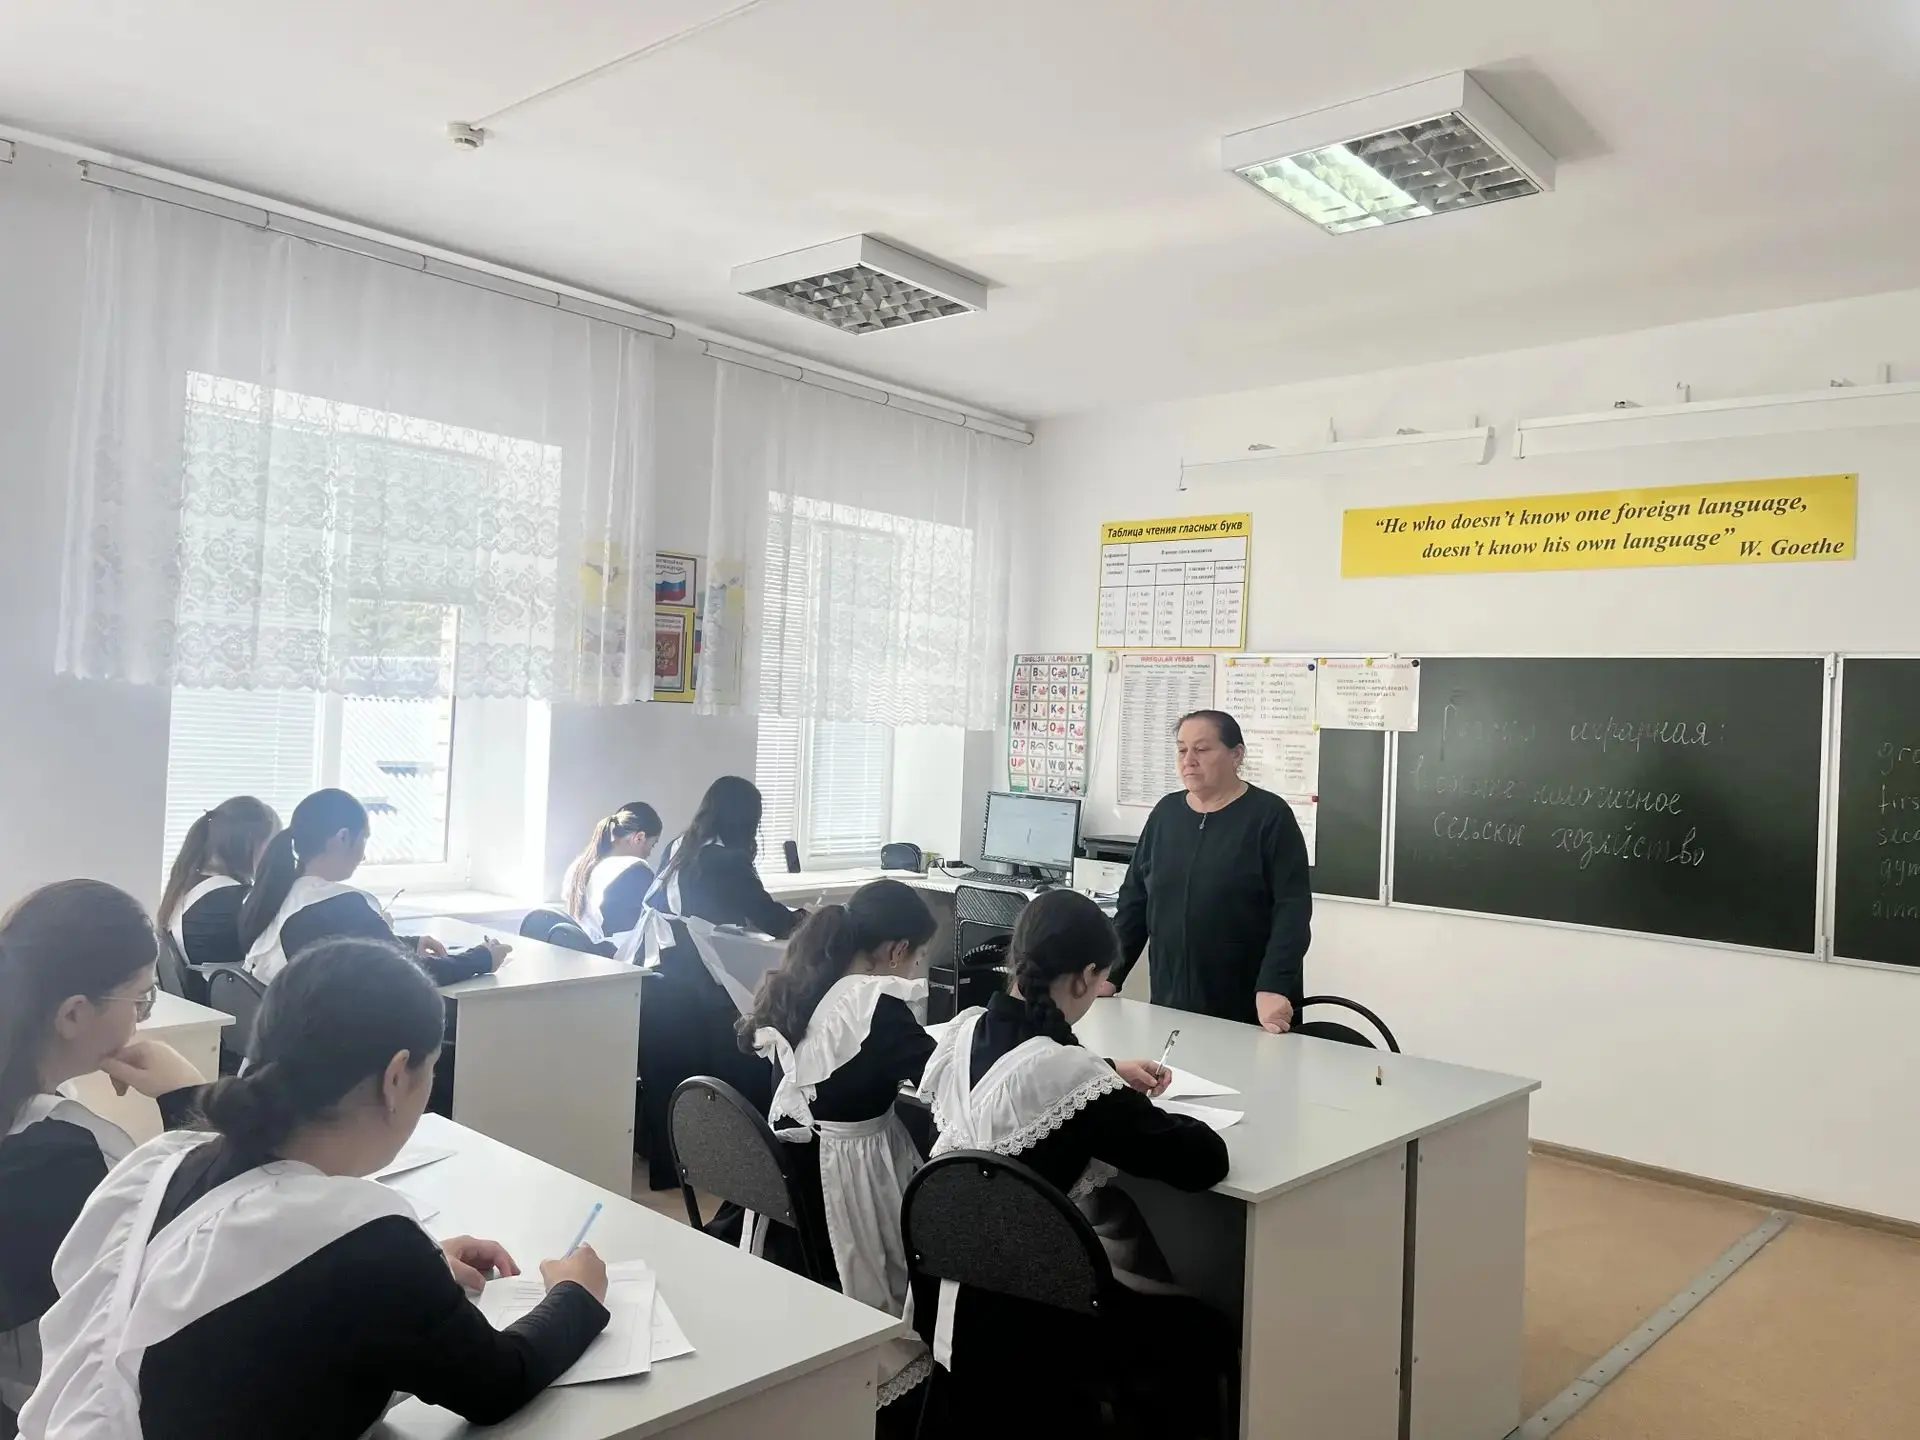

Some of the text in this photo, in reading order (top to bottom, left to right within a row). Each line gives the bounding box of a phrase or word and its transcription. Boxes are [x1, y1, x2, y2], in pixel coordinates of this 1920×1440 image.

[1412, 515, 1446, 532] who
[1451, 511, 1515, 530] doesn’t
[1519, 509, 1570, 526] know
[1575, 508, 1610, 523] one
[1612, 499, 1690, 525] foreign
[1698, 495, 1808, 518] language,
[1107, 519, 1243, 539] Таблица чтения гласных букв
[1422, 540, 1484, 559] doesn’t
[1488, 539, 1537, 556] know
[1542, 535, 1570, 553] his
[1576, 537, 1616, 552] own
[1739, 537, 1845, 557] W. Goethe
